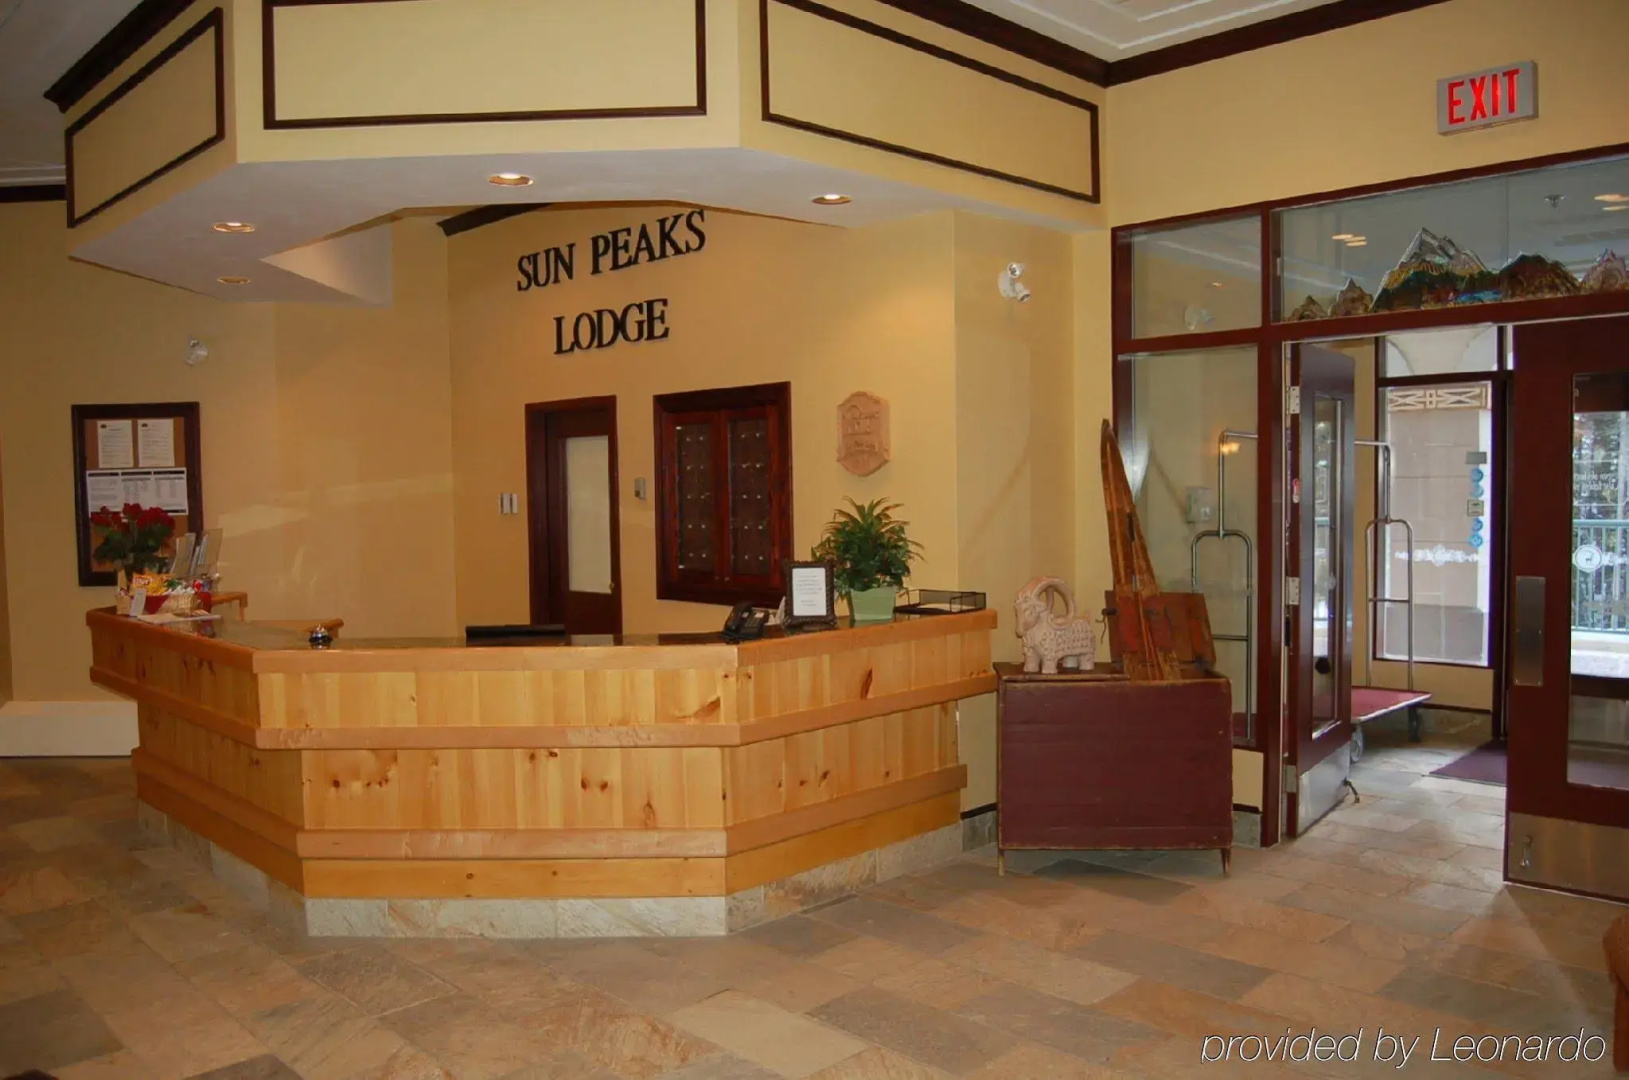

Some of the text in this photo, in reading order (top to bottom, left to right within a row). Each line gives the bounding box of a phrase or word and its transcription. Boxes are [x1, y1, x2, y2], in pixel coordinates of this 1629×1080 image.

[1447, 68, 1520, 125] EXIT
[517, 209, 706, 291] SUN PEAKS
[553, 298, 670, 355] LODGE
